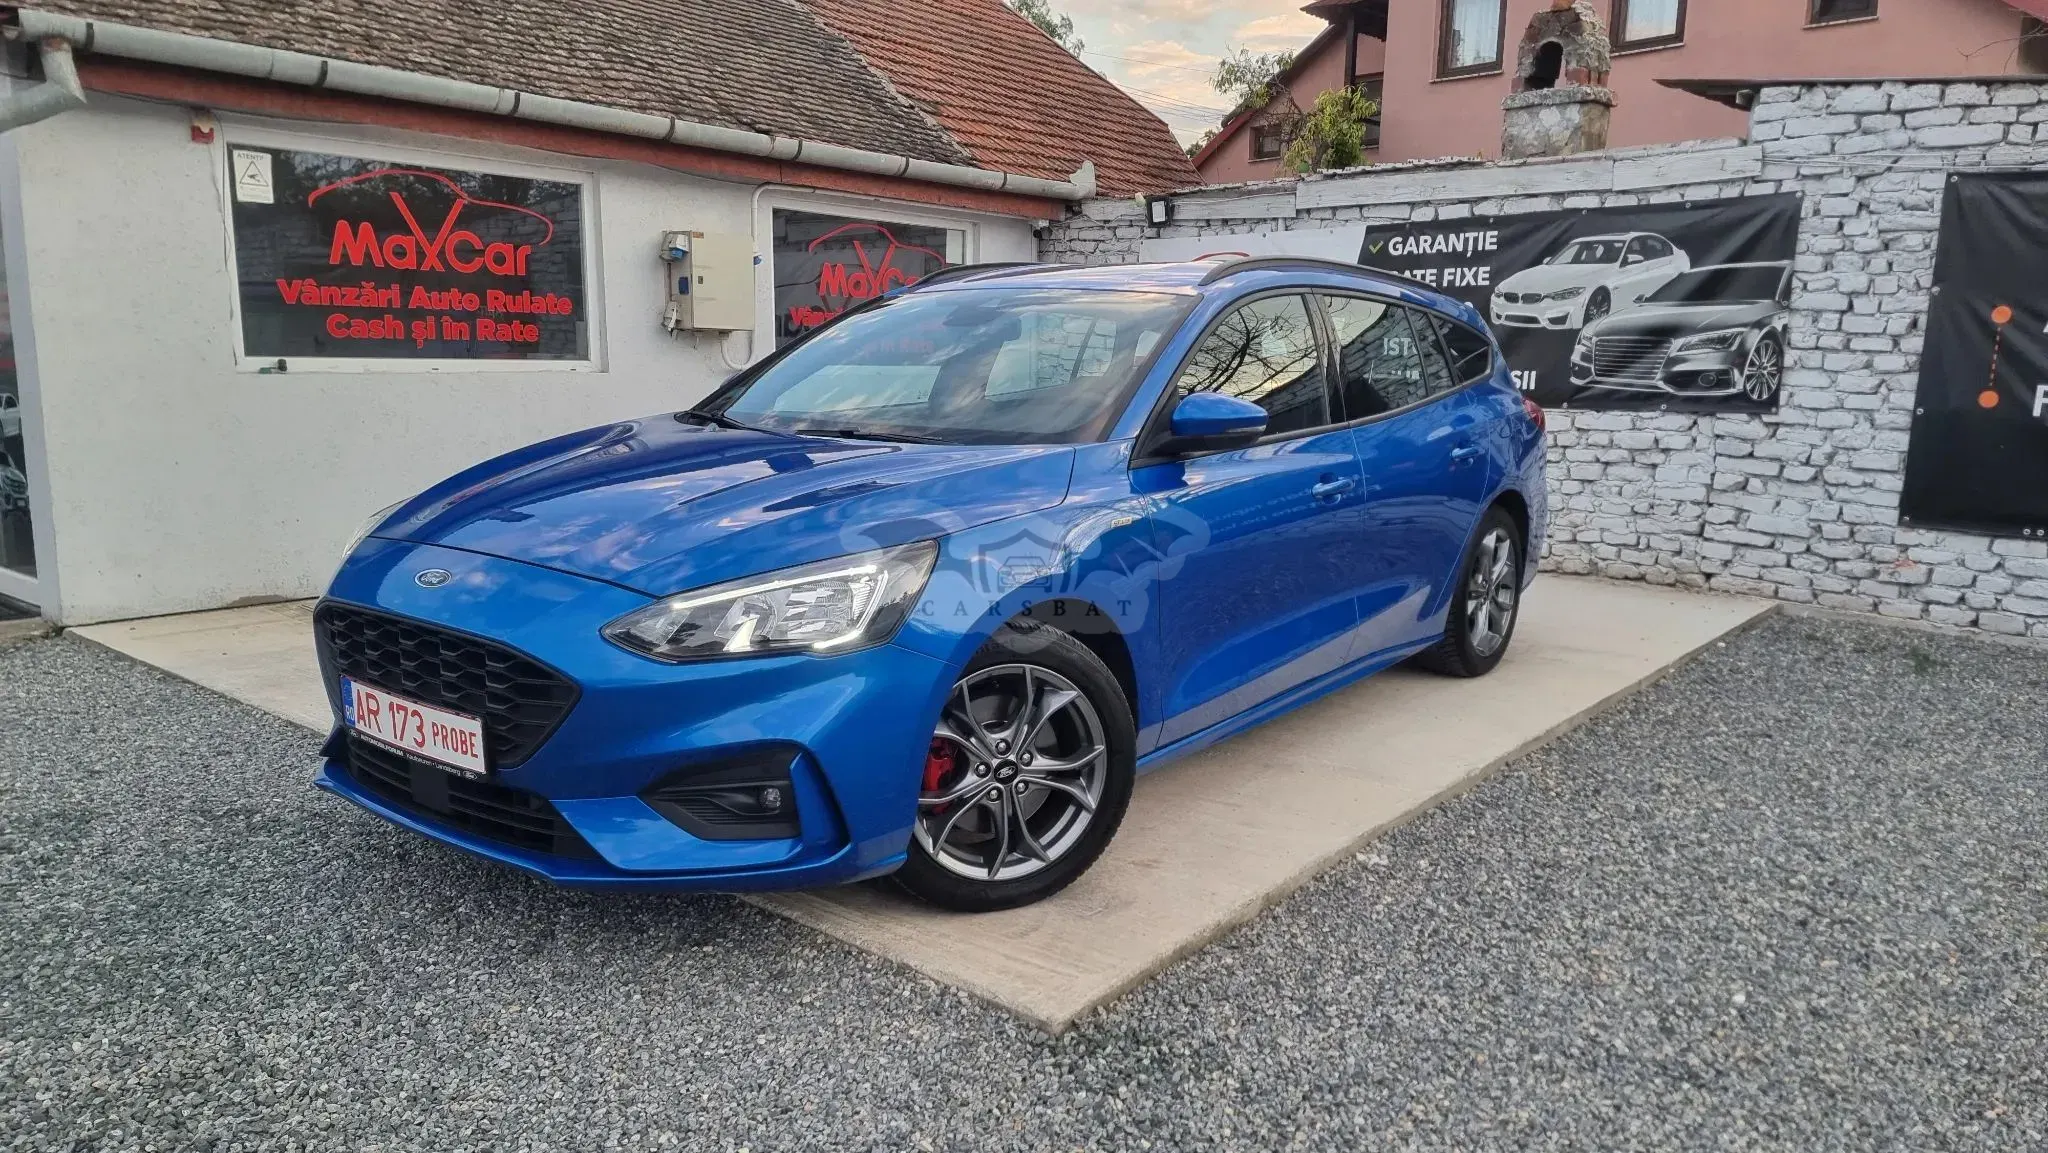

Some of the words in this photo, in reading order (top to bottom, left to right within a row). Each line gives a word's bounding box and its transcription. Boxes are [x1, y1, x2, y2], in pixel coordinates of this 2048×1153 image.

[1388, 230, 1498, 258] GARANȚIE
[1442, 266, 1490, 288] FIXE
[276, 278, 400, 308] Vânzări
[408, 286, 480, 311] Auto
[486, 289, 573, 315] Rulate
[326, 313, 404, 339] Cash
[411, 316, 436, 349] și
[440, 316, 470, 340] în
[476, 318, 539, 342] Rate
[356, 688, 382, 734] AR
[388, 701, 426, 748] 173
[432, 721, 479, 758] PROBE
